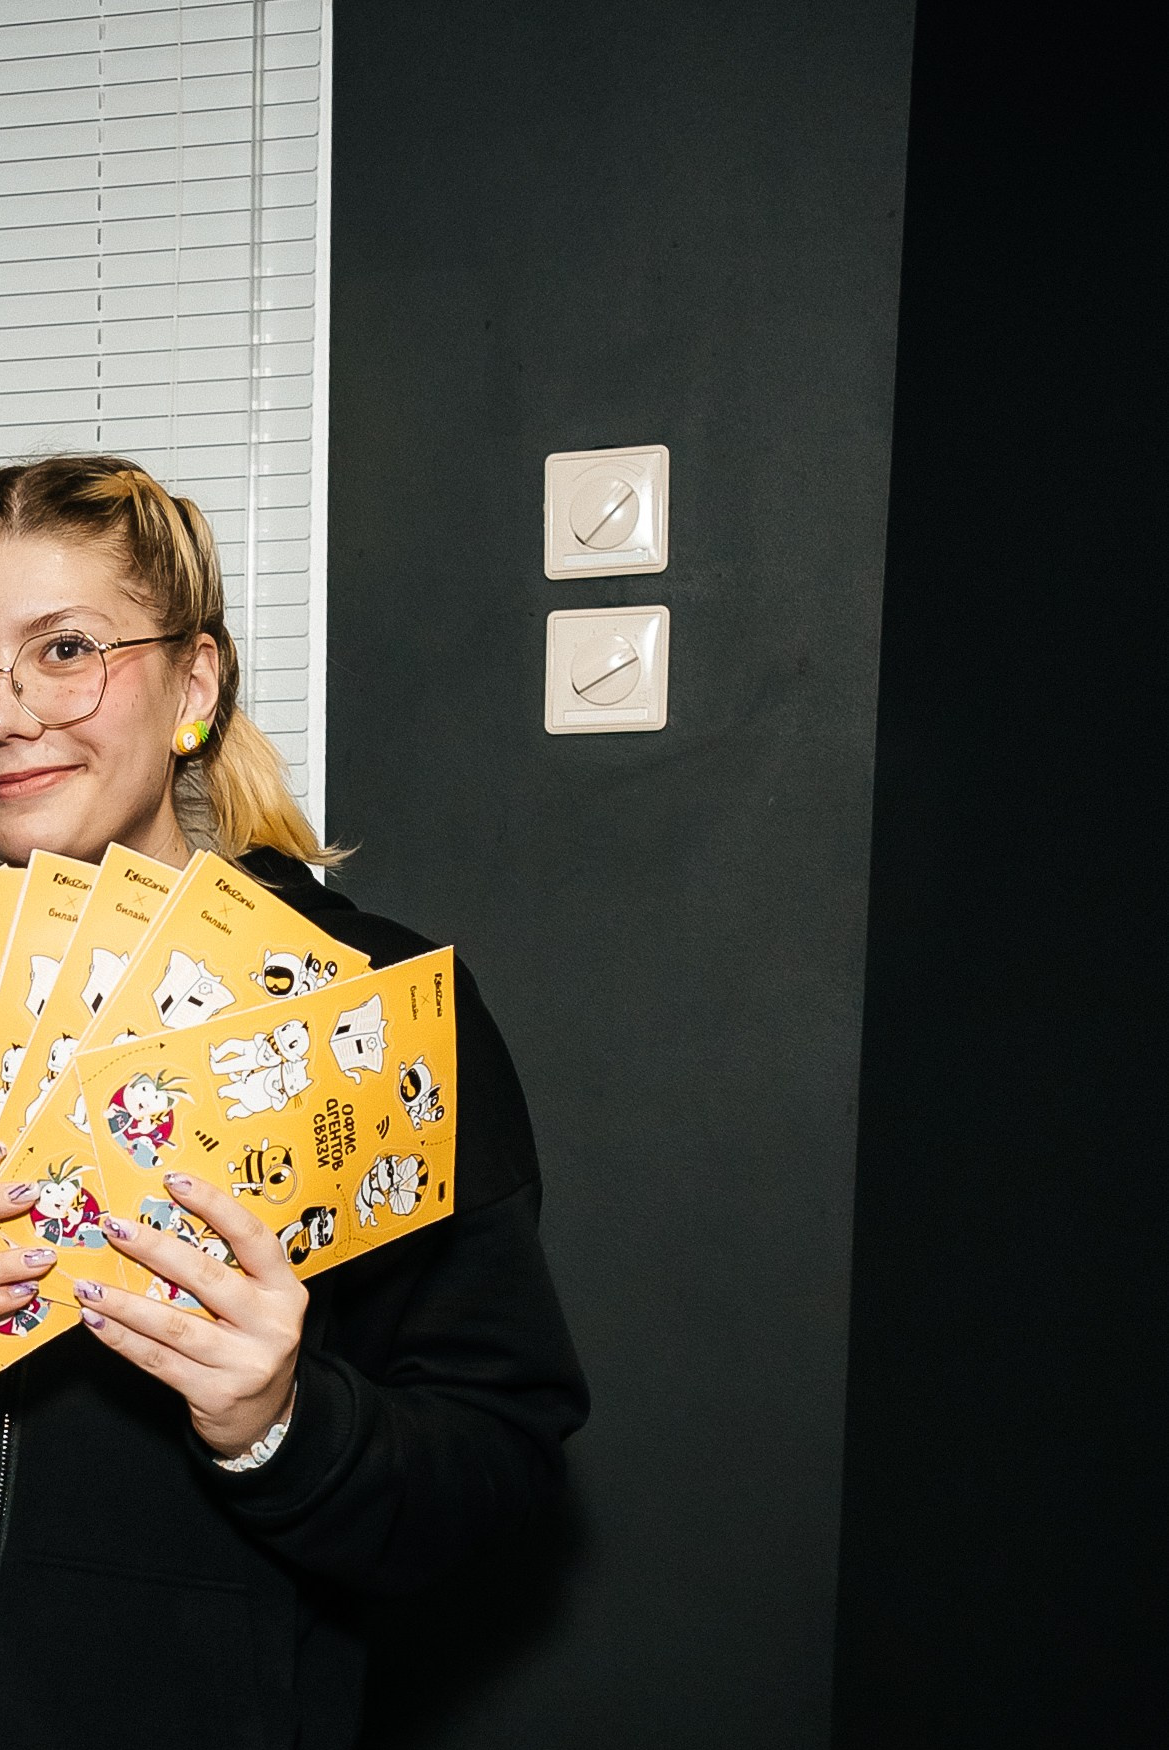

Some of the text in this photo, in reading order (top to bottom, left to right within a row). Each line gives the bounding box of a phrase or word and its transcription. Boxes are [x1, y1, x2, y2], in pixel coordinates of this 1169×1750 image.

[52, 872, 93, 891] KidZan
[123, 868, 170, 895] KidZania
[214, 878, 256, 911] KidZania
[48, 907, 79, 923] билай
[115, 902, 151, 924] билайн
[200, 910, 233, 936] билайн
[410, 985, 419, 1021] билайн
[434, 972, 443, 1018] KidZania
[313, 1113, 331, 1168] СВЯЗИ
[341, 1103, 357, 1156] ОФИС
